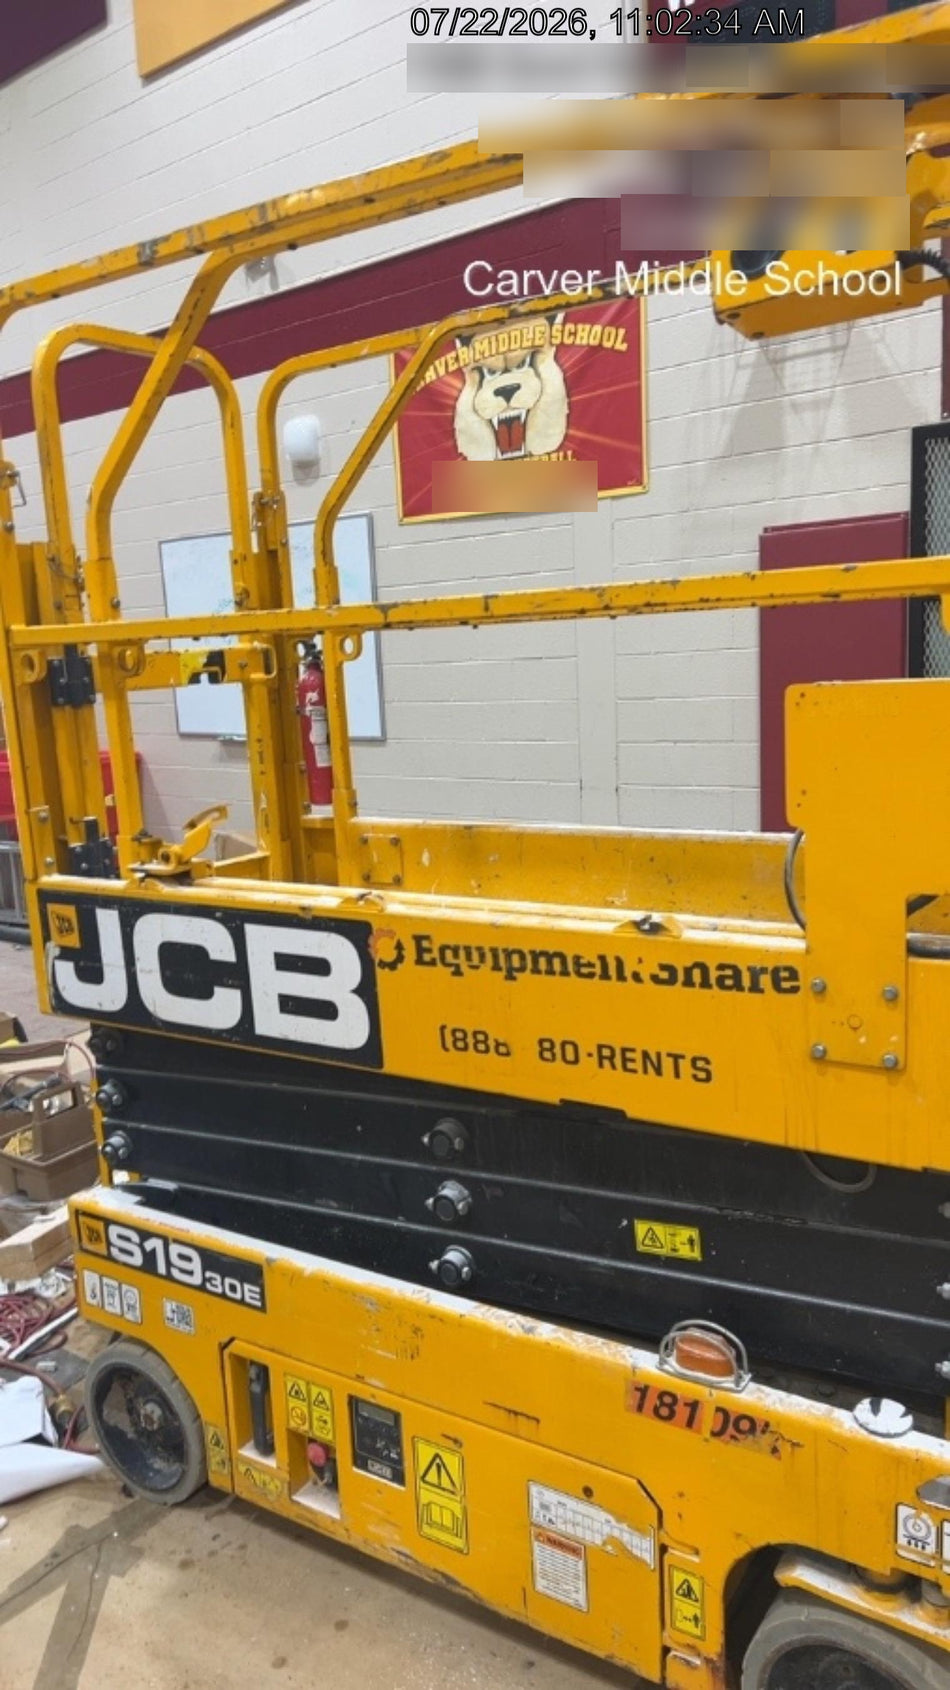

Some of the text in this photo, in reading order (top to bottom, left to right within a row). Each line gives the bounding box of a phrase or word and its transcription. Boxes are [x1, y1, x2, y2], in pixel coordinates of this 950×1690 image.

[473, 324, 547, 362] MIDDLE
[551, 323, 628, 351] SCHOOL
[54, 908, 371, 1050] JCB
